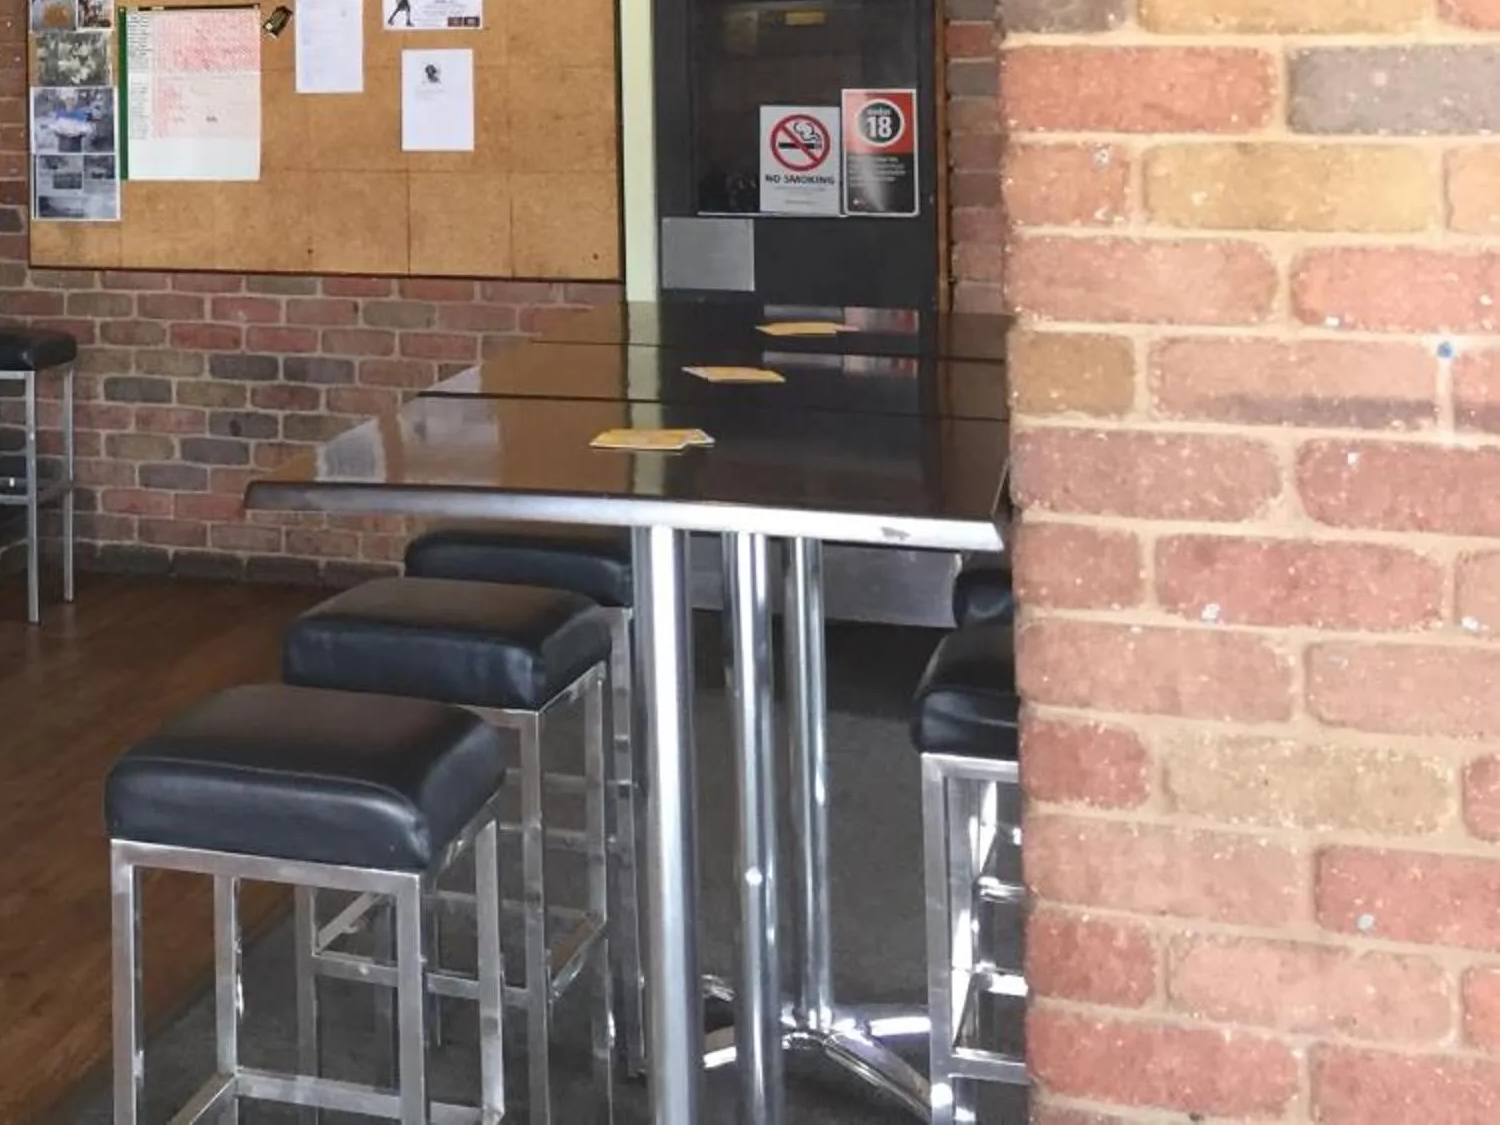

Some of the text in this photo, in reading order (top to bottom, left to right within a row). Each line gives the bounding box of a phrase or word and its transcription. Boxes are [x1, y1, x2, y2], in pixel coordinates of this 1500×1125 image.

[867, 116, 893, 138] 18
[765, 174, 835, 185] NO SMOKING
